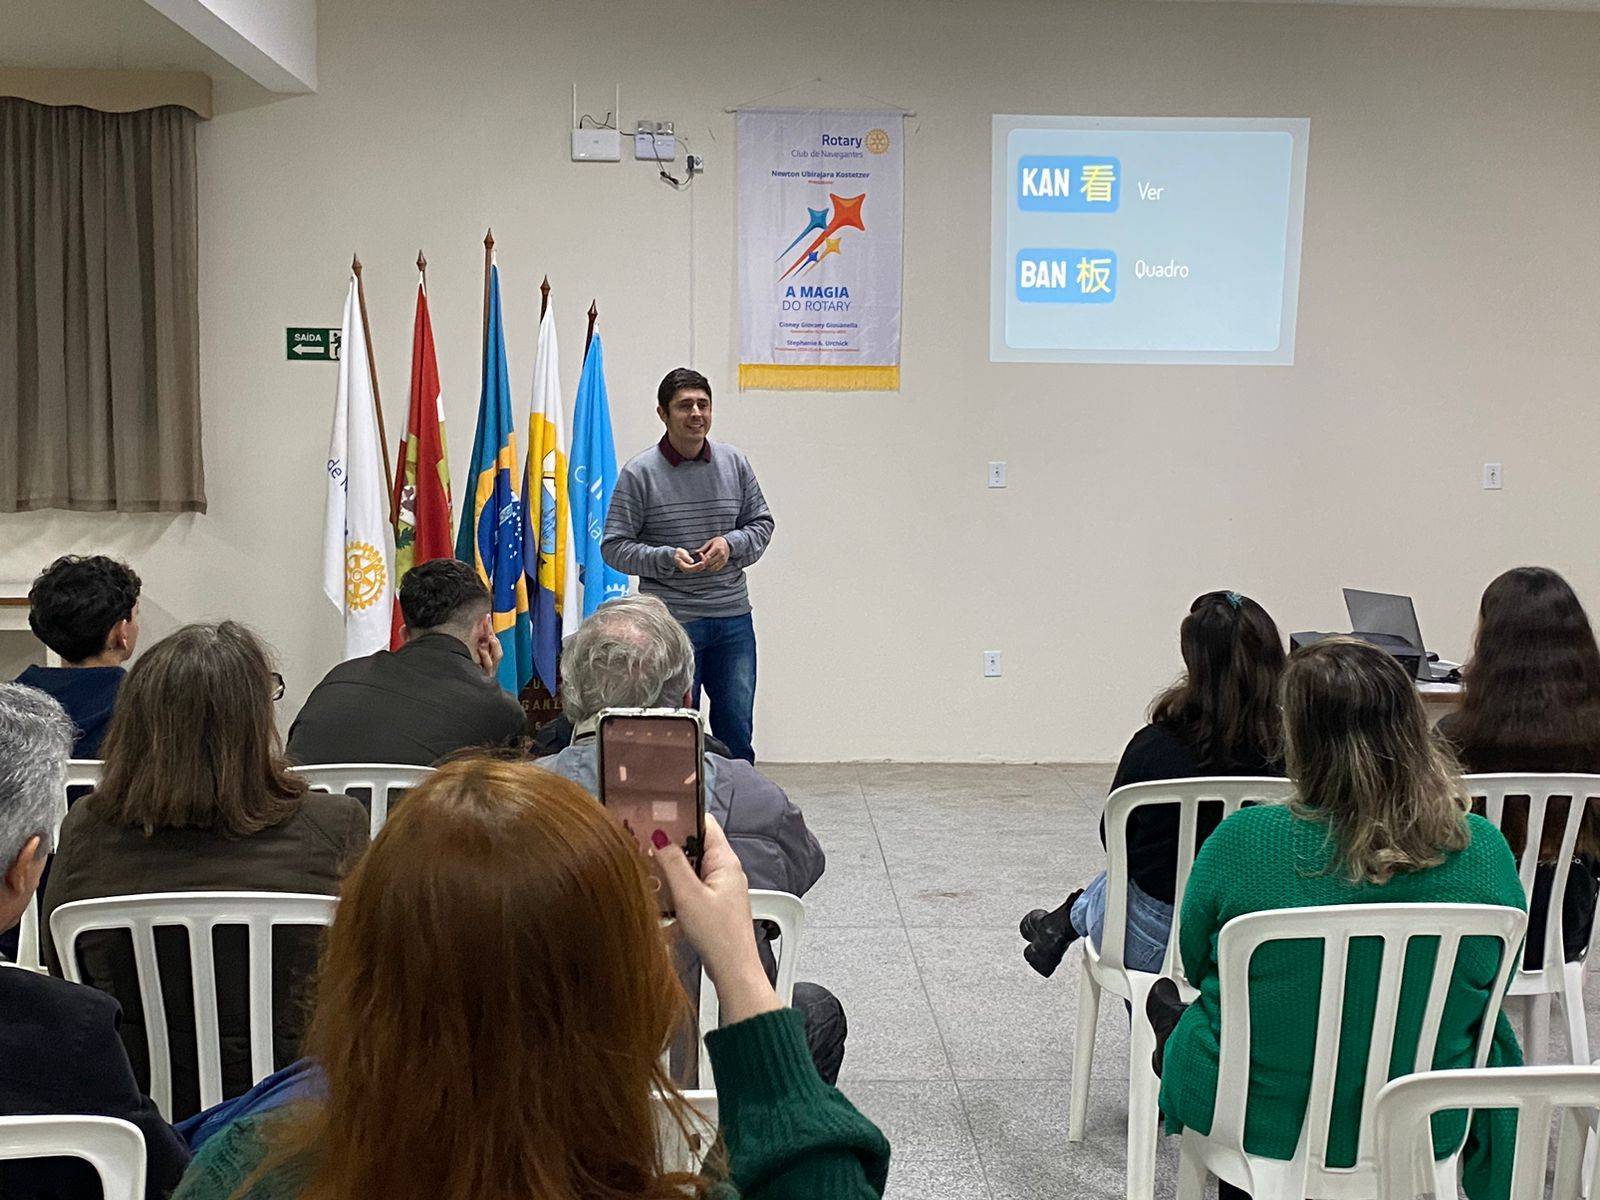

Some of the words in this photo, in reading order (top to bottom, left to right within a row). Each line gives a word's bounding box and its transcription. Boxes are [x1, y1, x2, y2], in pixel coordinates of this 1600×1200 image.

[822, 134, 862, 148] Rotary
[791, 149, 808, 157] Club
[821, 150, 863, 159] Navegantes
[771, 170, 800, 178] Newton
[1022, 167, 1070, 197] KAN
[1080, 164, 1116, 202] 看
[1137, 181, 1164, 200] Ver
[1021, 260, 1067, 288] BAN
[1076, 256, 1111, 293] 板
[1134, 259, 1189, 279] Quadro
[785, 286, 796, 298] A
[800, 286, 849, 298] MAGIA
[782, 300, 801, 311] DO
[805, 300, 851, 311] ROTARY
[294, 331, 322, 342] SAÍDA
[327, 459, 343, 479] de
